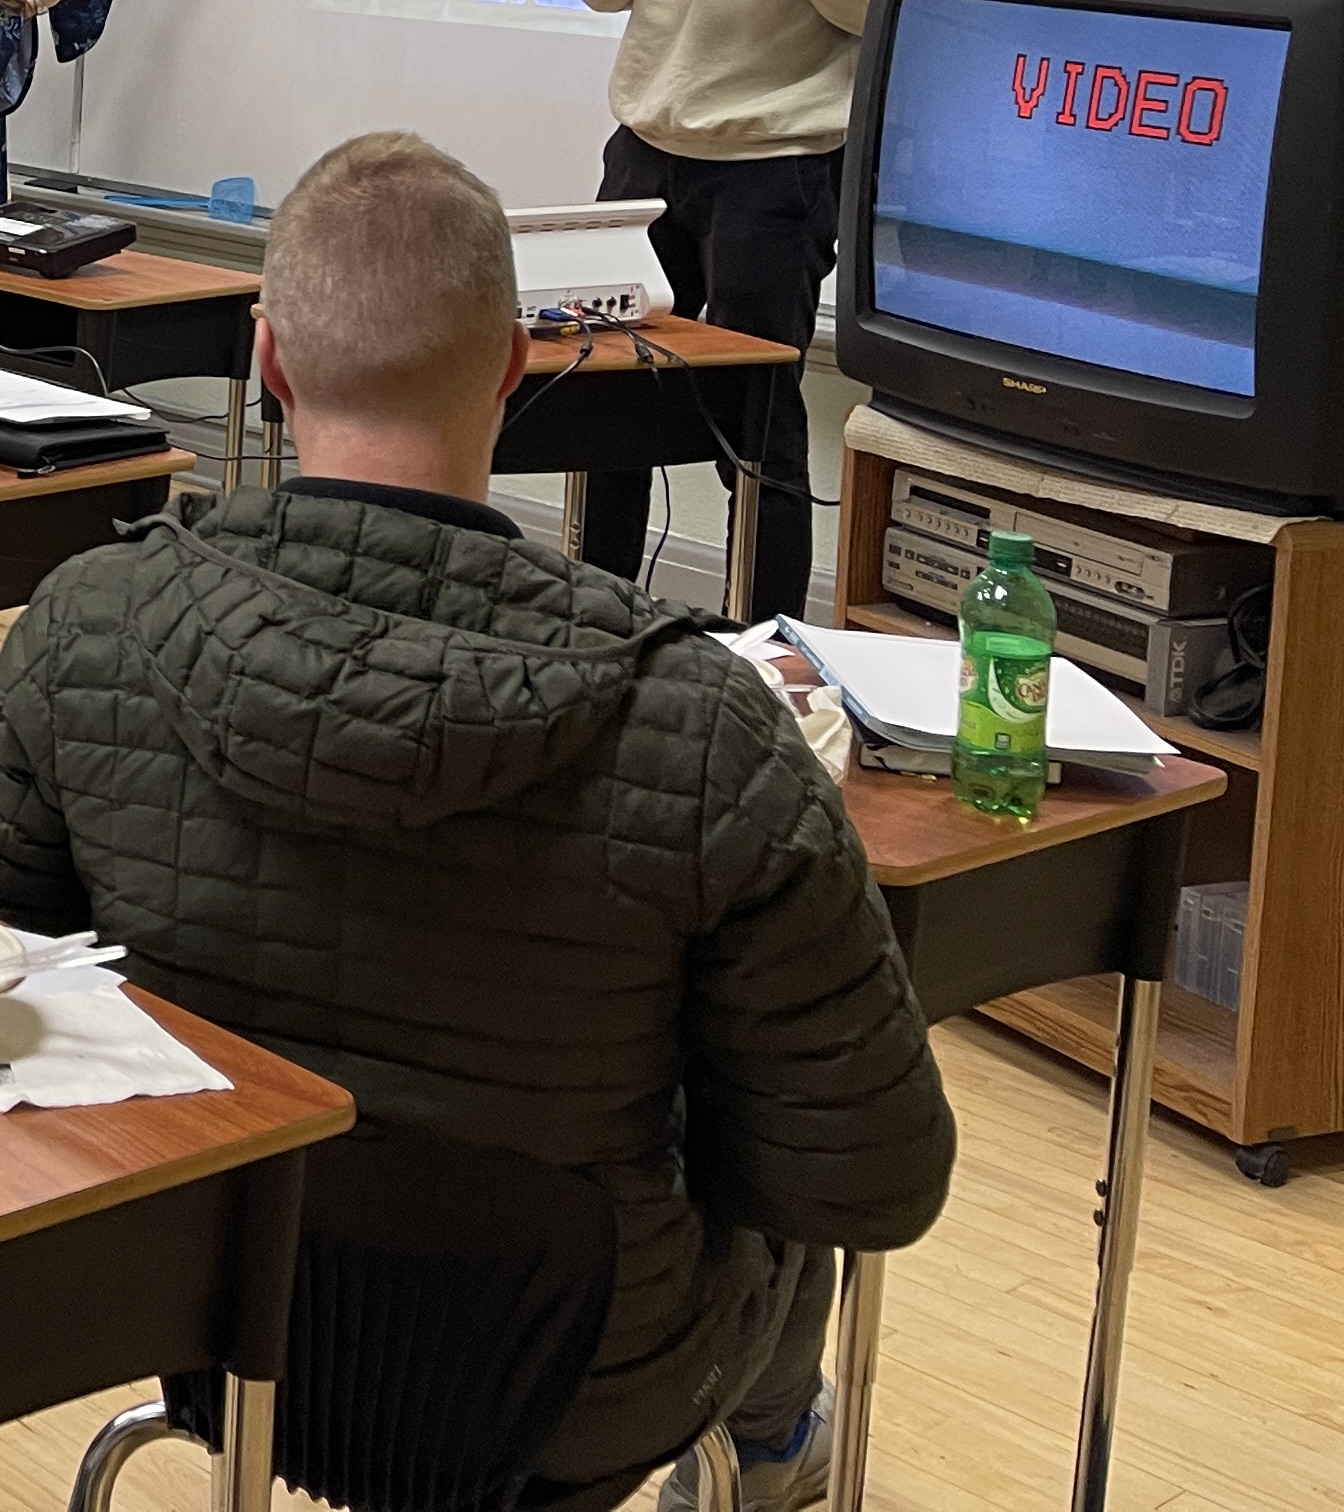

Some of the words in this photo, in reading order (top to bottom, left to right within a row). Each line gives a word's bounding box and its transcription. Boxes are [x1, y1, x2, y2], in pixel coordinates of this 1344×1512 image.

[1012, 53, 1229, 147] VIDEO
[1002, 377, 1047, 394] SHARP
[1169, 640, 1188, 687] TDK
